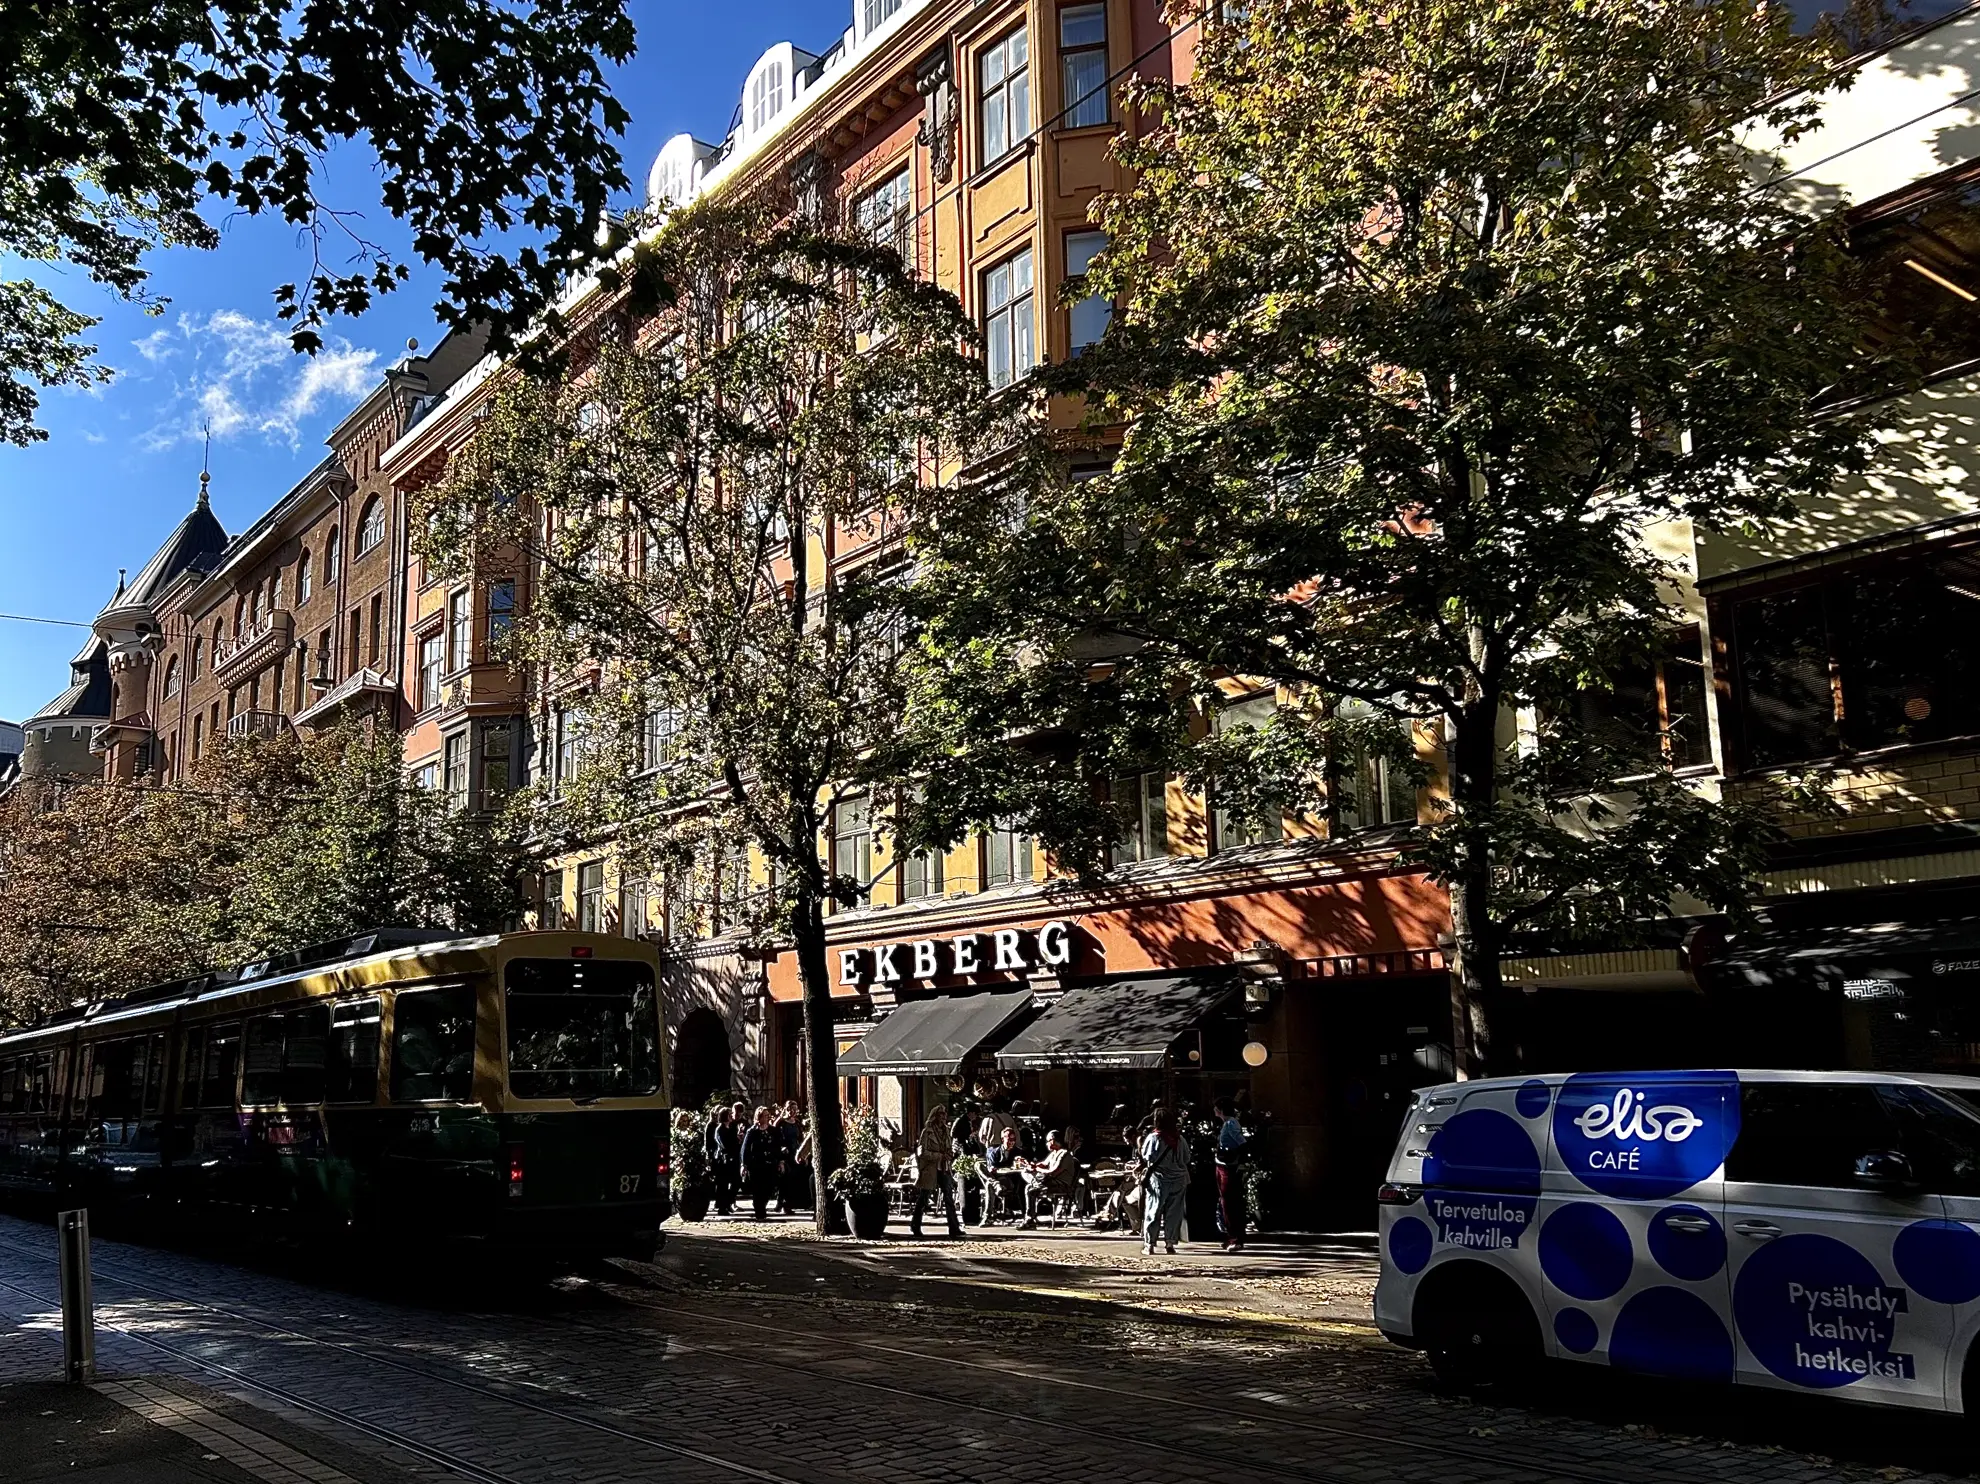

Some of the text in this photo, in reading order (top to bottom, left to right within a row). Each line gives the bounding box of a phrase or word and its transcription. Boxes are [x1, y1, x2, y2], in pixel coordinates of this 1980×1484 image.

[838, 921, 1069, 984] EKBERG
[1573, 1088, 1703, 1142] elisa
[1588, 1146, 1641, 1171] CAFÉ
[619, 1174, 641, 1194] 87
[1433, 1199, 1526, 1223] Tervetuloa
[1444, 1224, 1513, 1248] kahville
[1788, 1281, 1898, 1319] Pysähdy
[1807, 1312, 1885, 1344] kahvi-
[1795, 1342, 1905, 1378] hetkeksi
